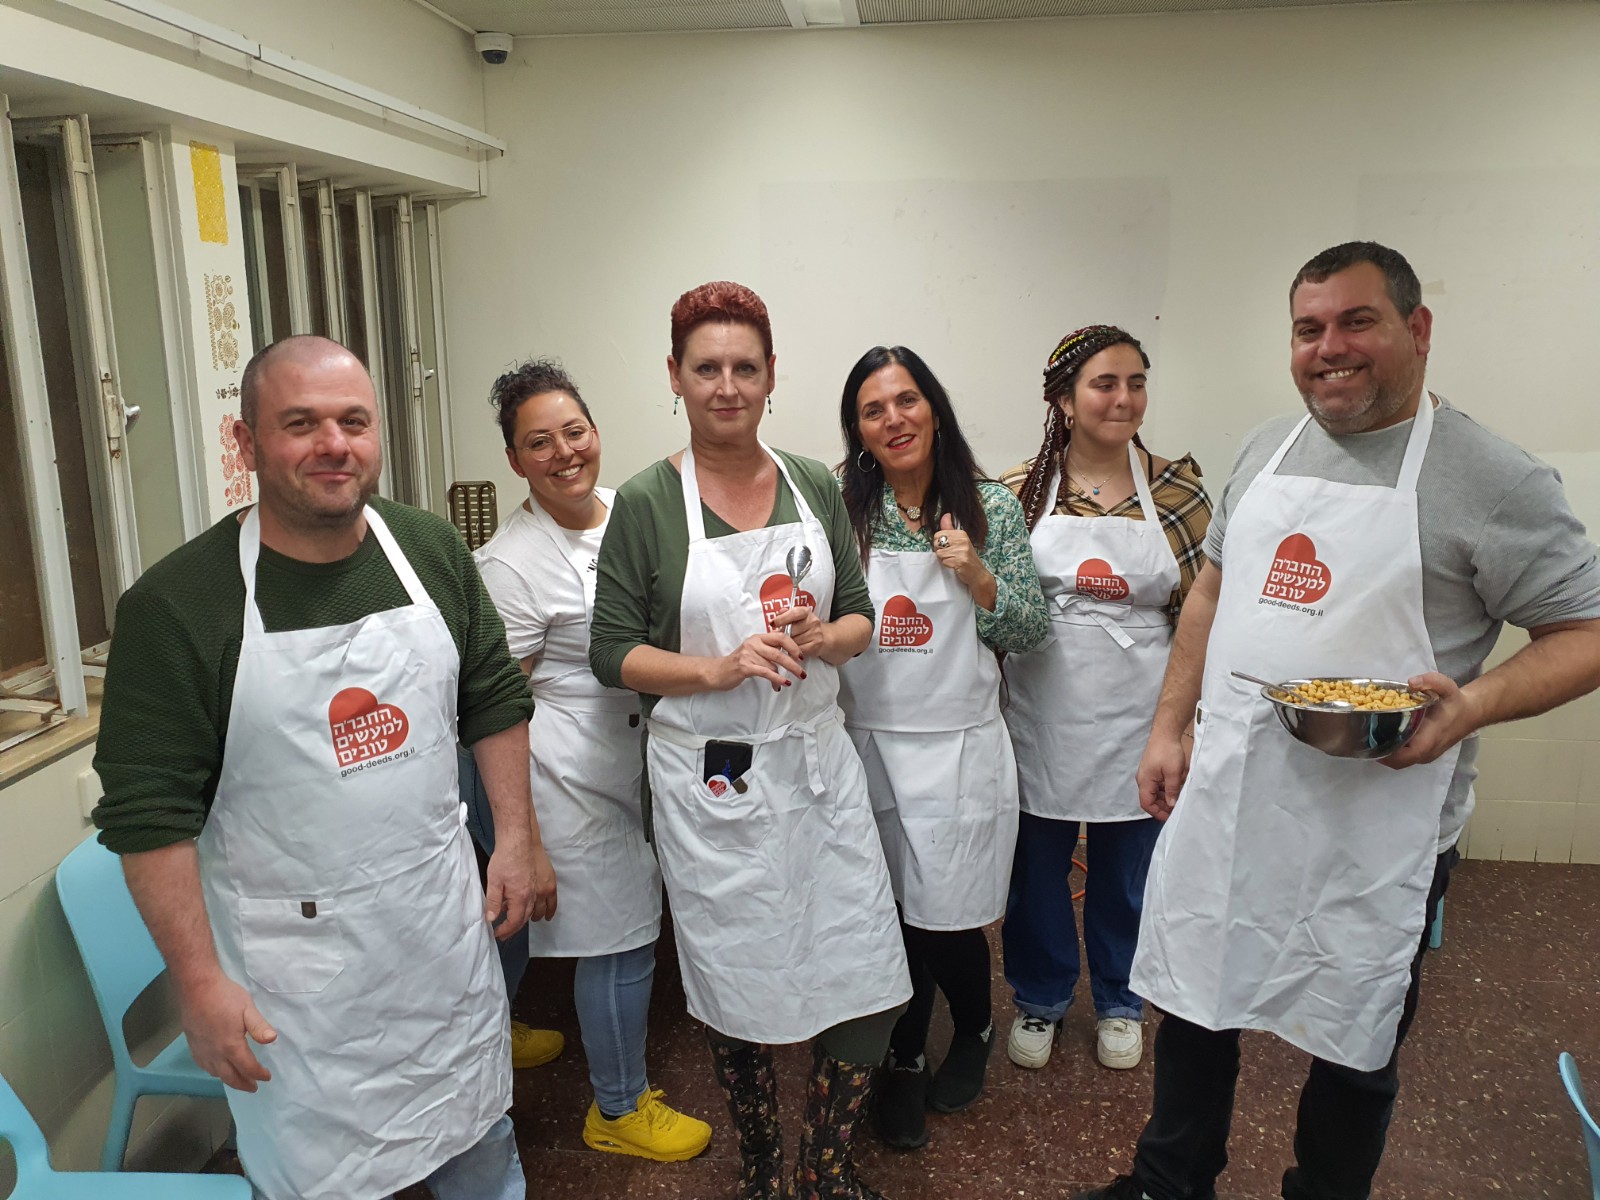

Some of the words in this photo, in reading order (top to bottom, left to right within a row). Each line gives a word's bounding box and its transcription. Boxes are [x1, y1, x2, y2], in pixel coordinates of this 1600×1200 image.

[1271, 571, 1326, 590] למעשים
[1266, 583, 1306, 600] טובים
[1258, 597, 1324, 616] good-deeds.org.il
[882, 624, 929, 635] למעשים
[881, 636, 915, 645] טובים
[336, 718, 403, 748] למעשים
[339, 739, 388, 764] טובים
[341, 747, 415, 777] good-deeds.org.il
